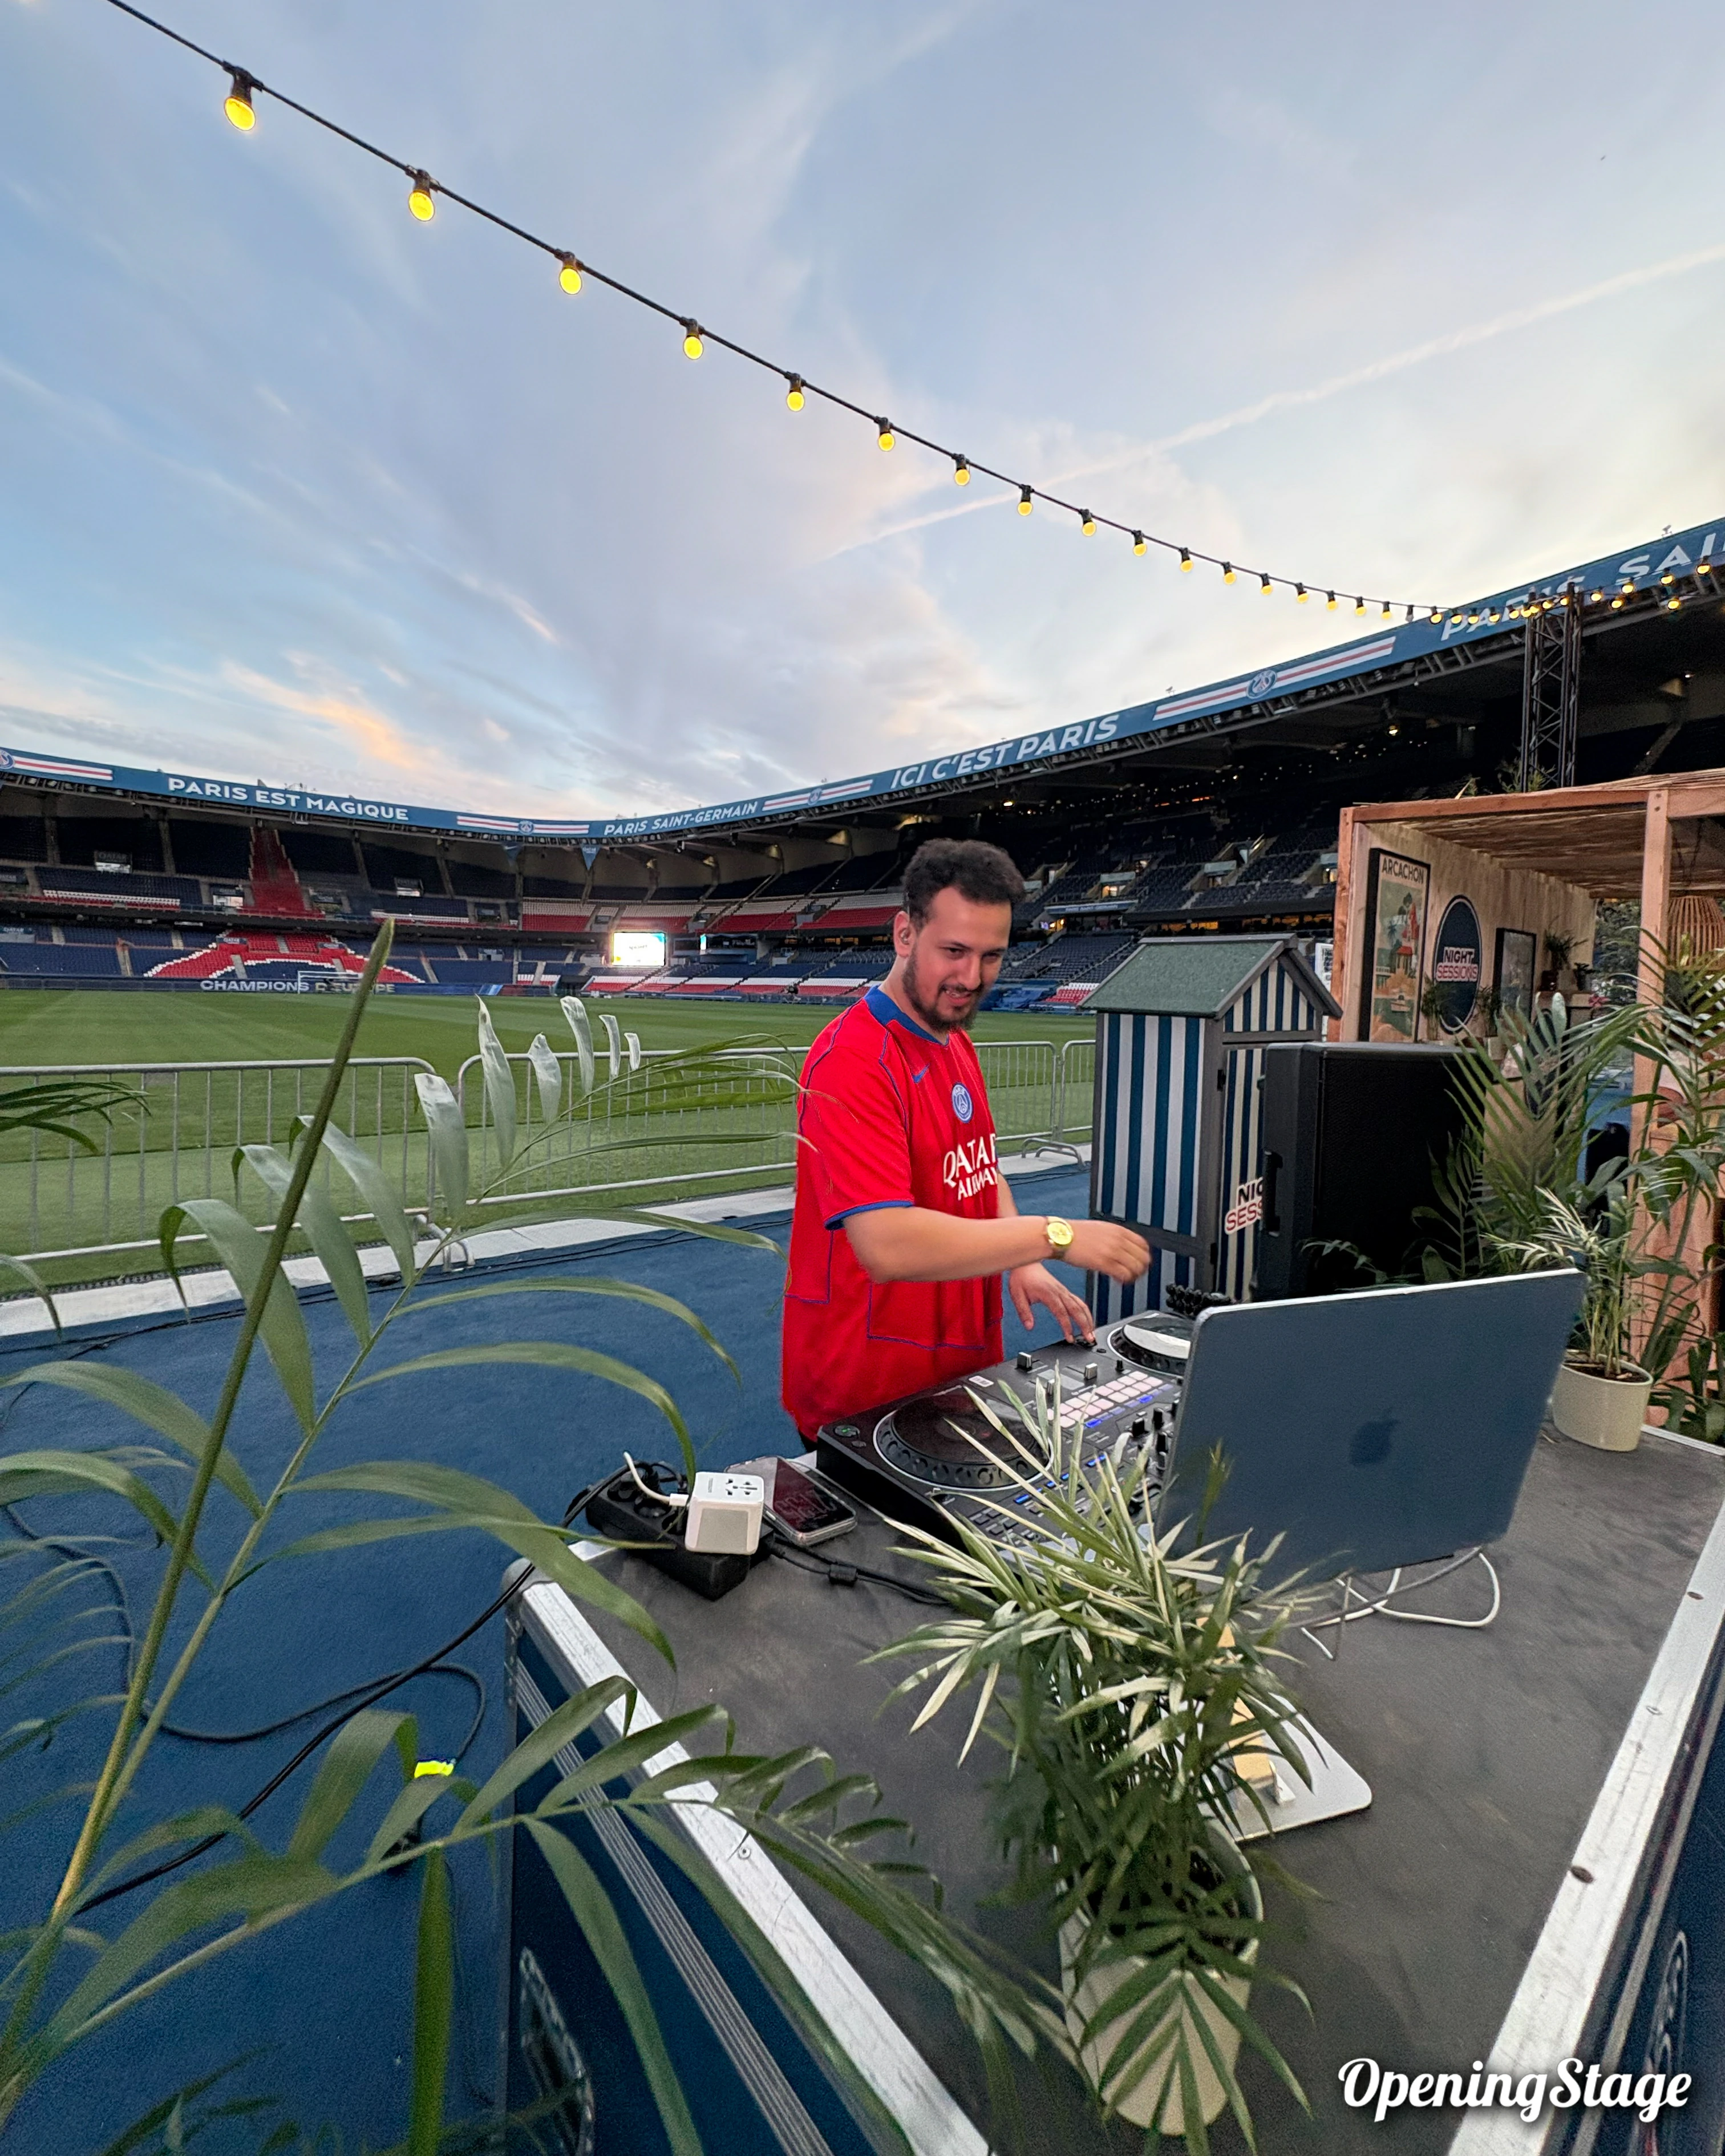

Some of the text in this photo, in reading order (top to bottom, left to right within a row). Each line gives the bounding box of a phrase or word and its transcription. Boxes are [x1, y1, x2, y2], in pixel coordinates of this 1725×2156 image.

[1615, 533, 1725, 586] SAI
[890, 714, 1120, 790] ICI C'EST PARIS
[168, 777, 410, 821] PARIS EST MAGIQUE
[604, 801, 759, 836] PARIS SAINT-GERMAIN
[1381, 857, 1425, 884] ARCACHON
[1437, 964, 1478, 979] SESSIONS
[1444, 950, 1473, 964] NIGHT
[200, 980, 310, 992] CHAMPIONS
